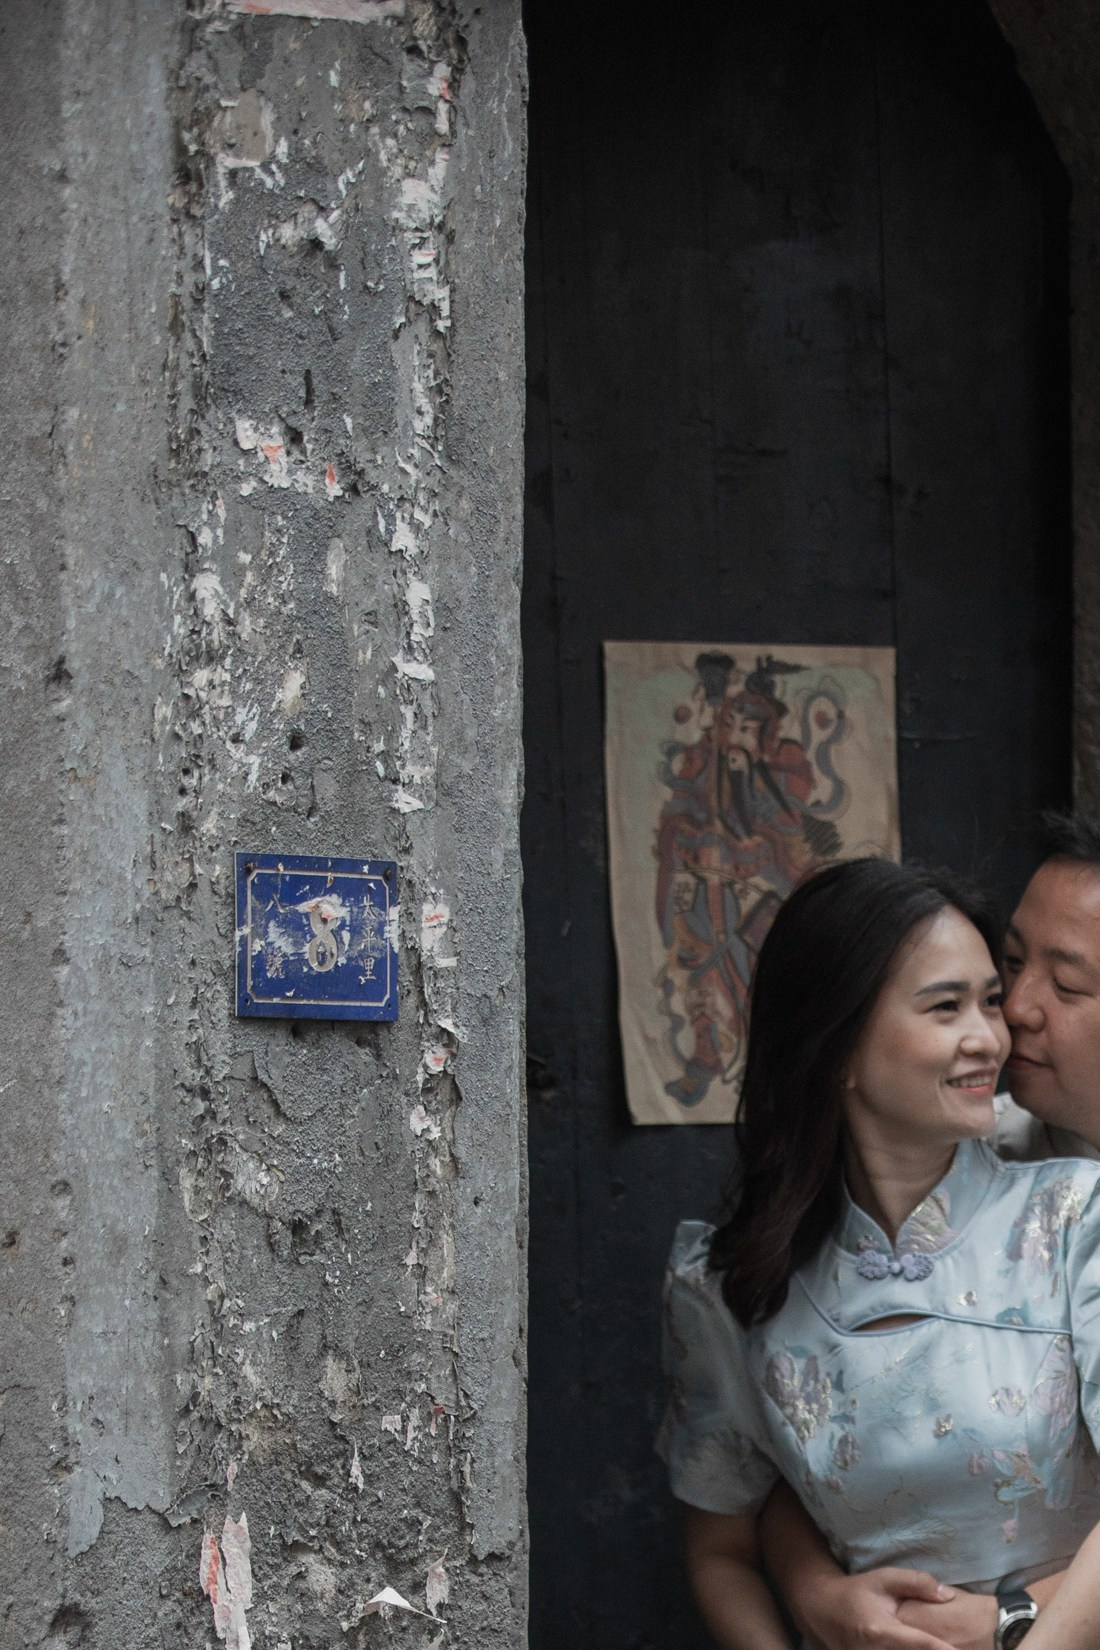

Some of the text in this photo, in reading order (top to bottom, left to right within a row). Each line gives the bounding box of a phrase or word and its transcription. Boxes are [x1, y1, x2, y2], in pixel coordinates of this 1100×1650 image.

[307, 905, 340, 972] 8
[361, 893, 378, 981] 太平里
